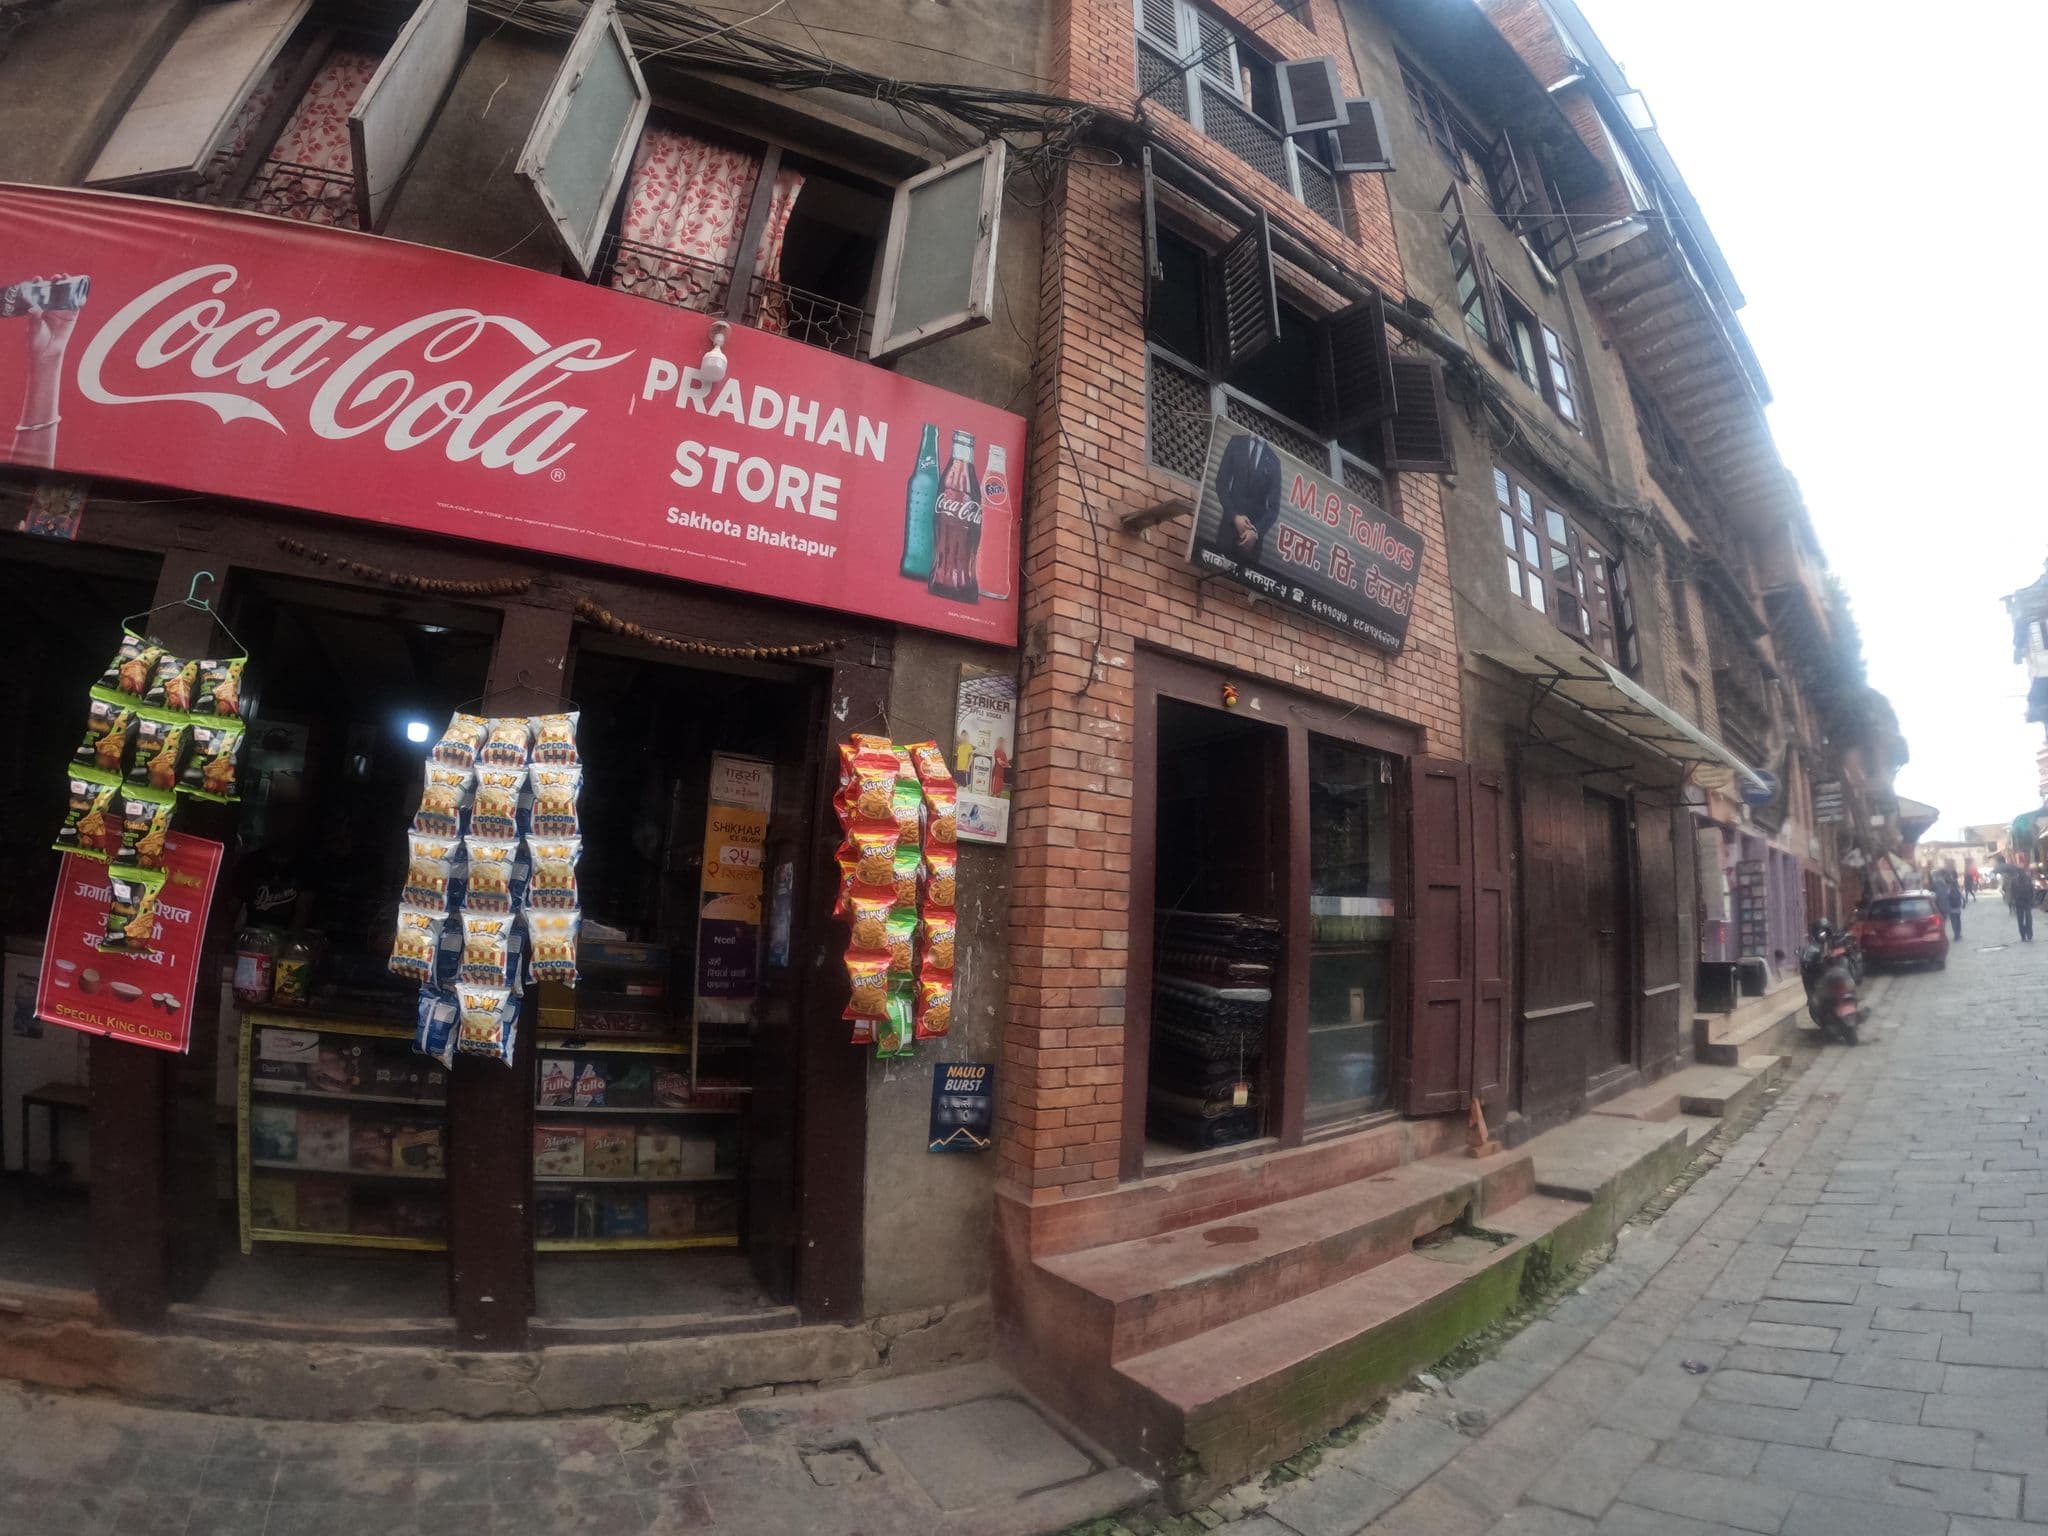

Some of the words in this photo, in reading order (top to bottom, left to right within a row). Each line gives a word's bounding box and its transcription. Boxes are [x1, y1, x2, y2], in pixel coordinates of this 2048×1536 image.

[77, 264, 635, 476] Coca-Cola
[642, 357, 889, 463] PRADHAN
[670, 440, 842, 521] STORE
[667, 506, 741, 538] Sakhota
[746, 524, 837, 560] Bhaktapur
[1347, 504, 1415, 573] Tailors
[965, 693, 1010, 713] STRIKER
[712, 821, 761, 836] SHIKHAR
[713, 936, 737, 945] Ncell
[55, 1003, 104, 1027] SPECIAL
[106, 1017, 136, 1033] KING
[138, 1025, 172, 1041] CURD
[947, 1065, 986, 1079] NAULO
[542, 1078, 572, 1091] Fullo
[576, 1079, 605, 1093] Fullo
[944, 1079, 983, 1091] BURST
